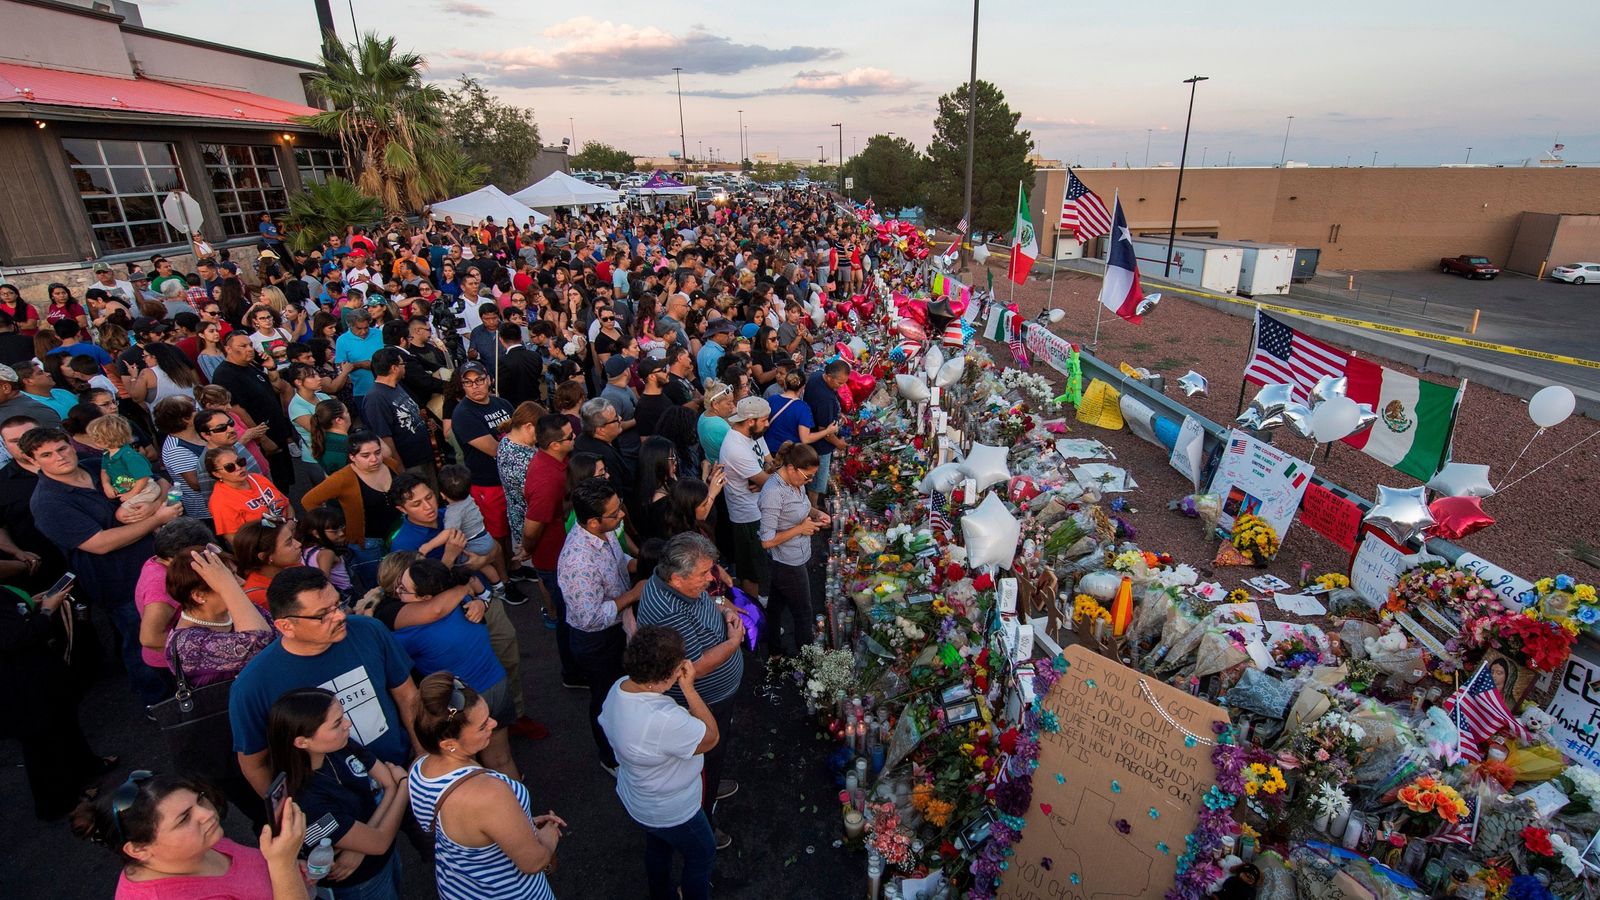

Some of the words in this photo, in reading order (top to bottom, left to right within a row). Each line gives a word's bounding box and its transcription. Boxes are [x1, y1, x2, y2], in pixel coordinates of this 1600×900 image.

[1252, 460, 1265, 470] UNITED
[1253, 443, 1261, 451] TWO
[1261, 448, 1283, 462] COUNTRIES
[1262, 456, 1276, 466] FAMILY
[1252, 469, 1265, 478] STAND
[1490, 575, 1528, 604] Pas
[339, 688, 367, 706] OSTE
[1074, 656, 1095, 674] IF
[1103, 669, 1127, 691] YOU
[1168, 701, 1200, 722] GOT
[1563, 660, 1600, 706] EL
[1071, 674, 1089, 695] TO
[1095, 689, 1136, 718] KNOW
[1140, 711, 1174, 738] OUR
[1090, 722, 1116, 745] THEN
[1120, 740, 1143, 760] YOU
[1098, 709, 1121, 731] OUR
[1171, 748, 1197, 771] OUR
[1549, 704, 1599, 747] United
[1042, 732, 1074, 754] CITY
[1063, 723, 1087, 745] SEEN
[1089, 739, 1112, 758] HOW
[1115, 752, 1164, 789] PRECIOUS
[1168, 785, 1192, 805] OUR
[1015, 854, 1043, 888] YOU
